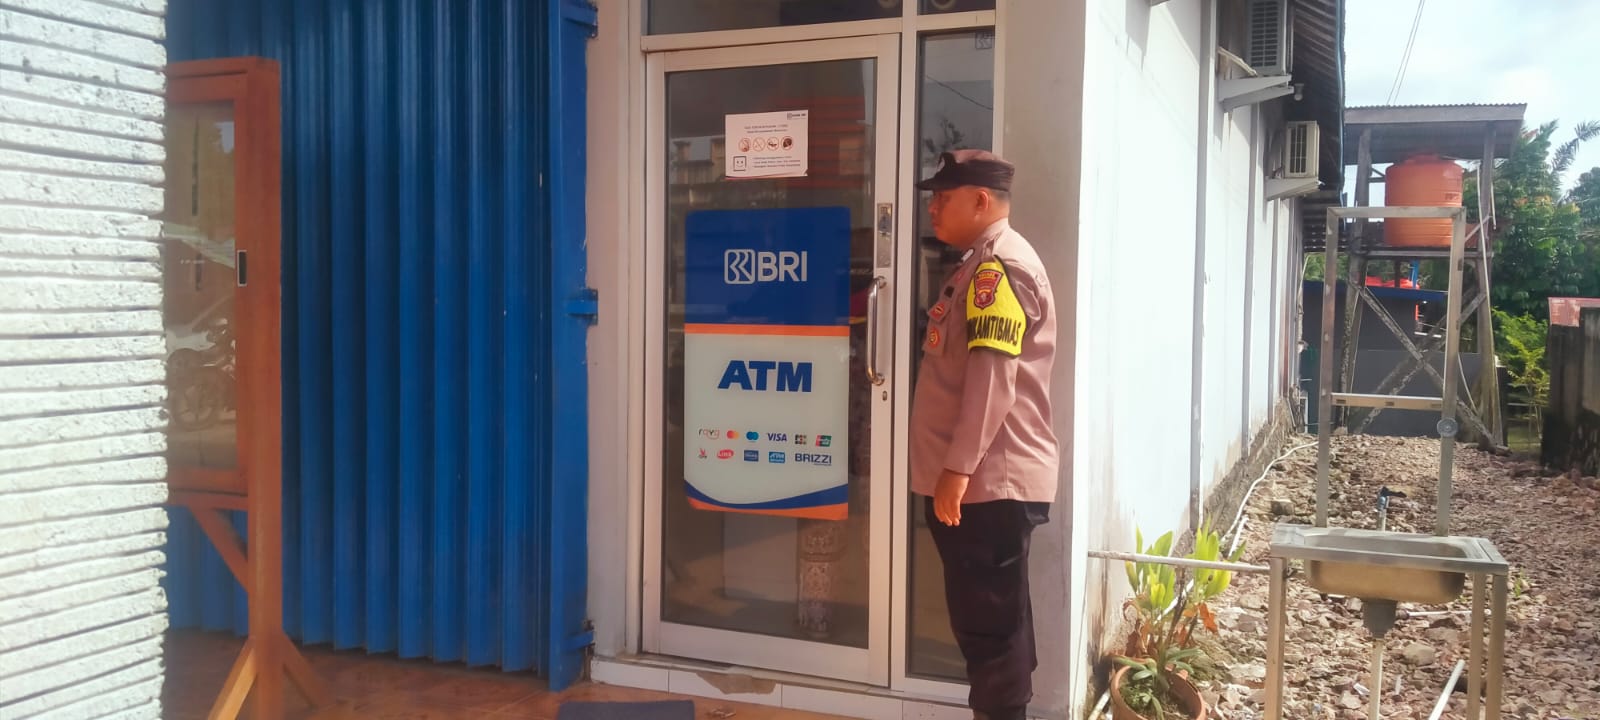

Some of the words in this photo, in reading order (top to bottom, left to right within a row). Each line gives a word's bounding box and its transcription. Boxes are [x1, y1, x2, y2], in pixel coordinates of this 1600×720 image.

[757, 251, 808, 282] BRI
[717, 360, 813, 392] ATM
[767, 433, 787, 442] VISA
[795, 453, 832, 464] BRIZZI
